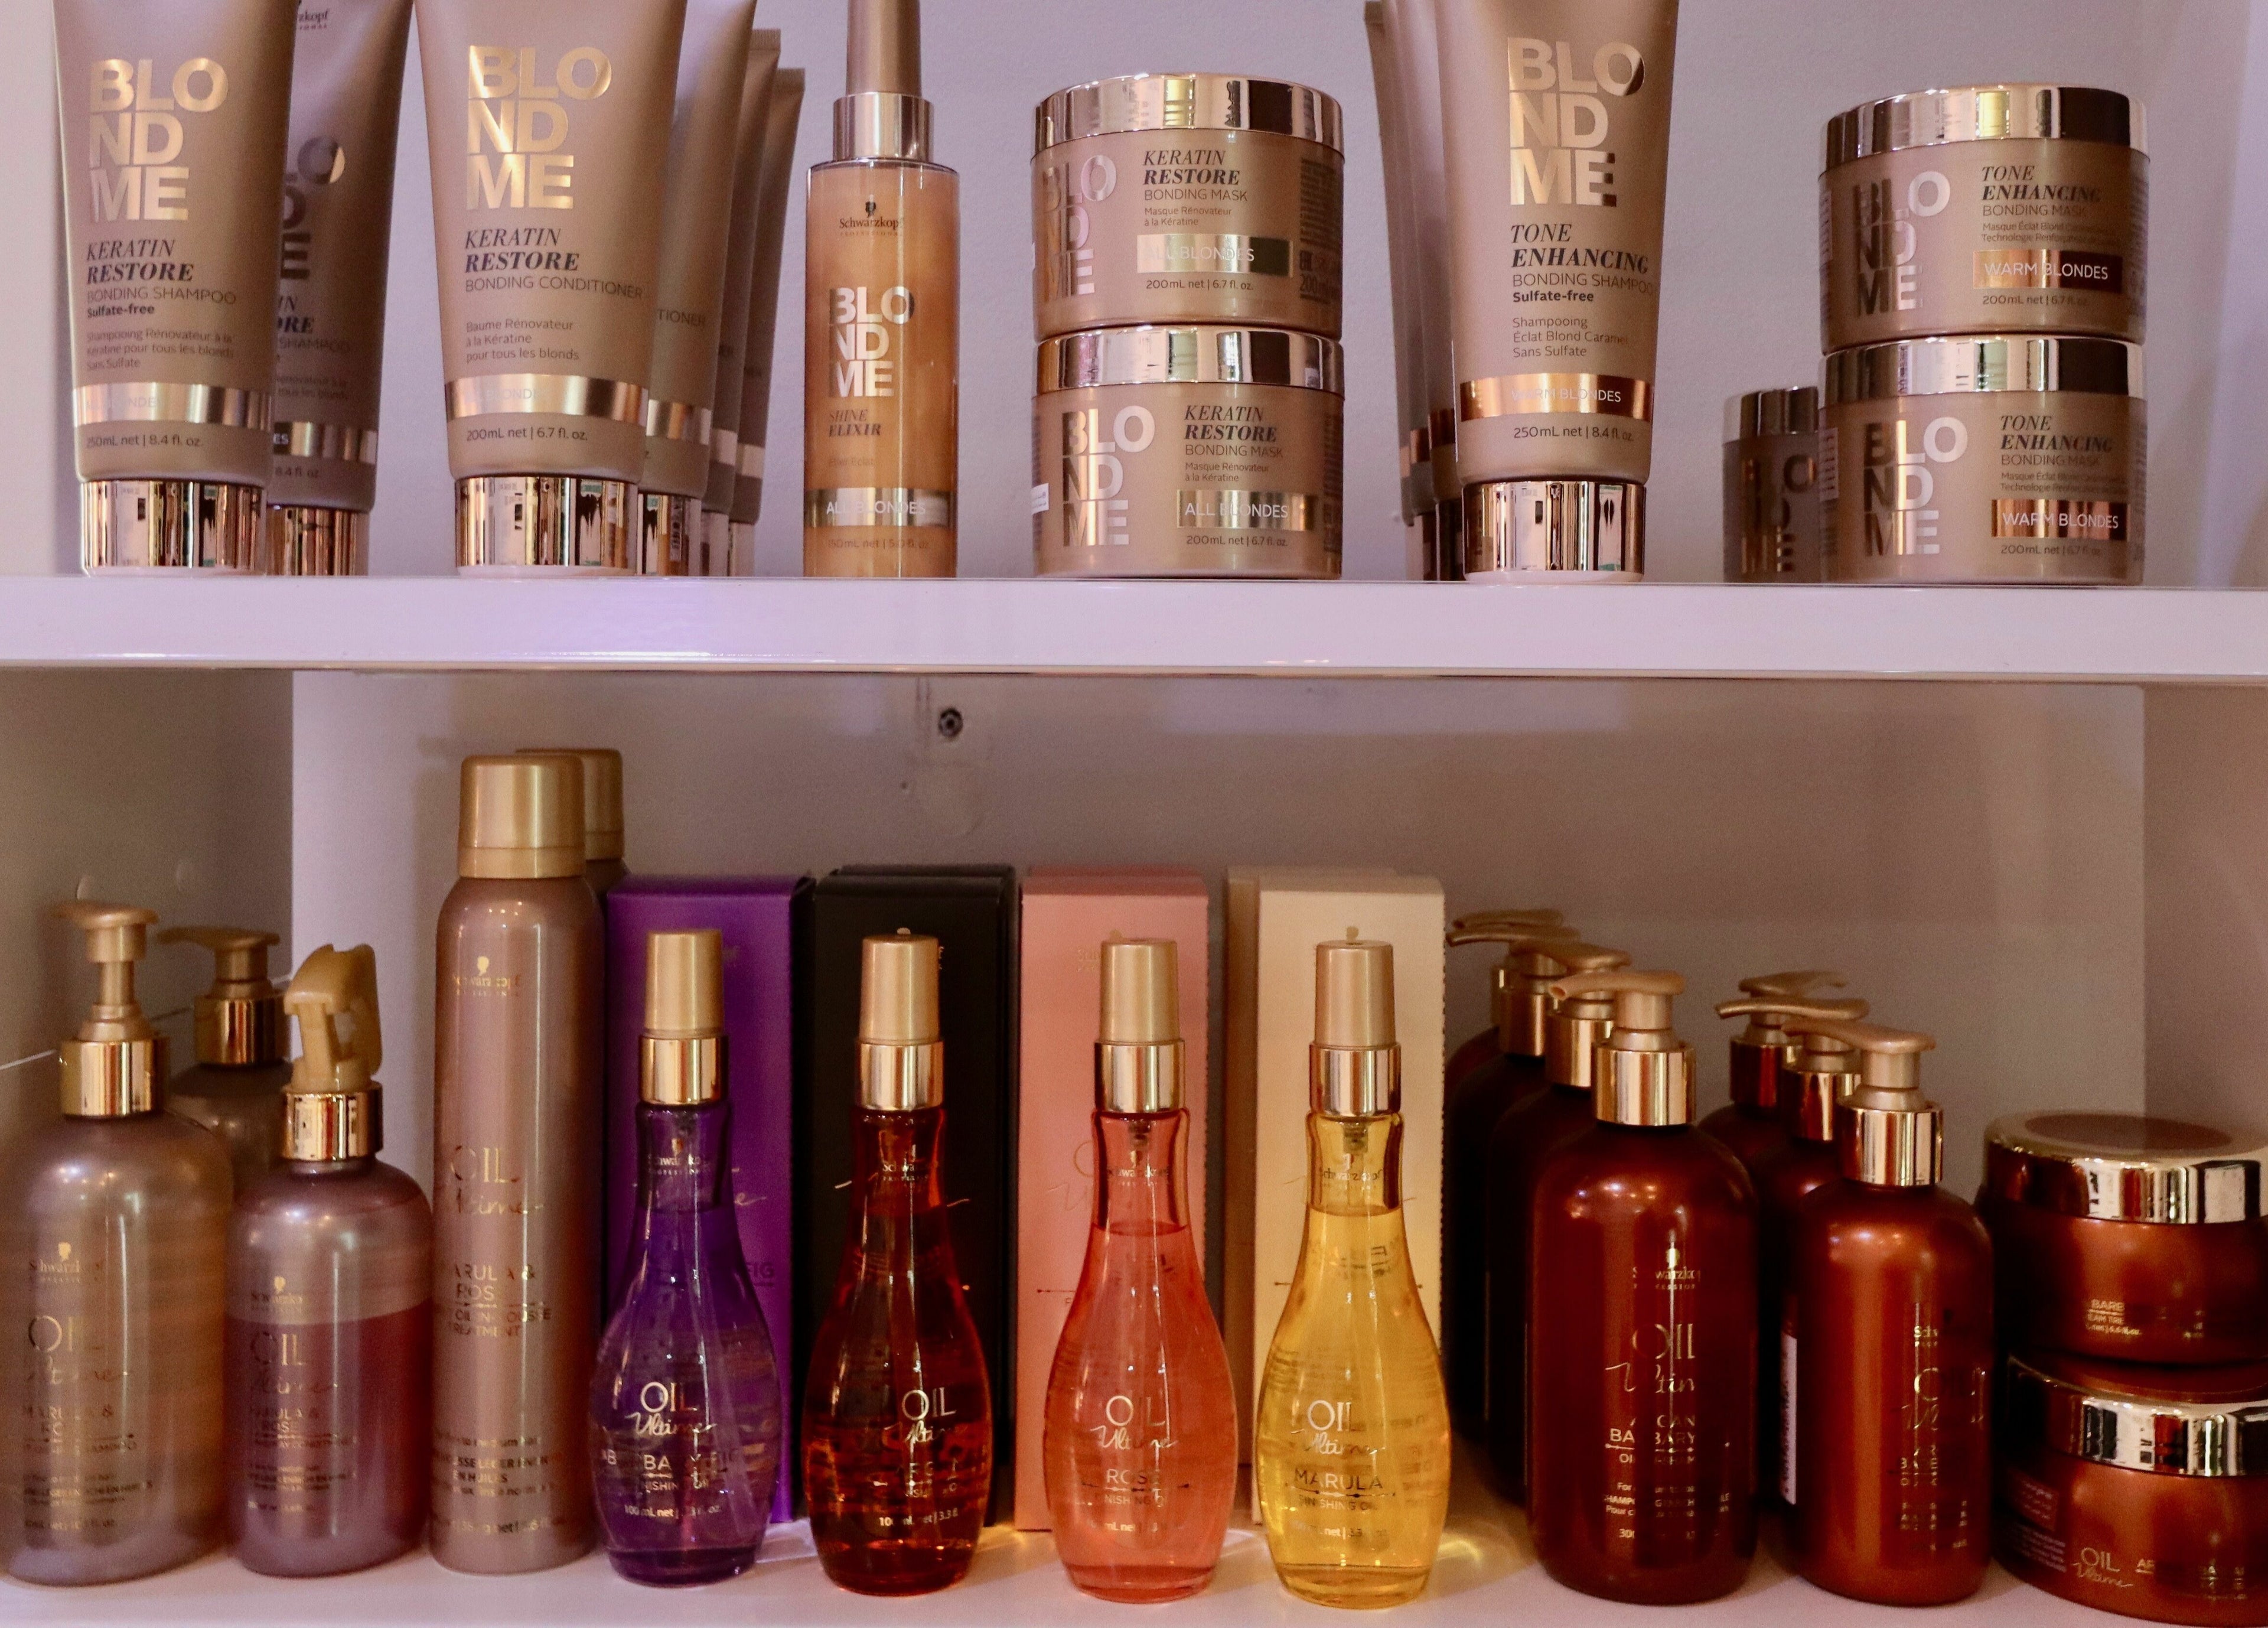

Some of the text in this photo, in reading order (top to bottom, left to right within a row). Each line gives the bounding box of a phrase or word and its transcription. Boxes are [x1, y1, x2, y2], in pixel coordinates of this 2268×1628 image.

[470, 45, 612, 100] BLO
[1507, 37, 1645, 96] BLO
[90, 58, 229, 113] BLO
[467, 100, 569, 154] ND
[1509, 92, 1608, 148] ND
[89, 112, 184, 168] ND
[1143, 149, 1226, 167] KERATIN
[467, 153, 574, 210] ME
[1143, 168, 1240, 186] RESTORE
[1510, 148, 1617, 207] ME
[1982, 165, 2035, 182] TONE
[90, 166, 189, 223] ME
[1144, 189, 1248, 202] BONDING MASK
[1982, 184, 2101, 203] ENHANCING
[1144, 206, 1232, 218] Masque Rénovateur
[1983, 204, 2048, 216] BONDING
[1152, 217, 1159, 226] la
[1161, 217, 1199, 226] Kératine
[465, 228, 561, 249] KERATIN
[1511, 223, 1572, 243] TONE
[87, 239, 175, 261] KERATIN
[1180, 246, 1255, 262] BLONDES
[465, 251, 579, 273] RESTORE
[1511, 248, 1649, 274] ENHANCING
[87, 262, 194, 284] RESTORE
[1513, 272, 1588, 287] BONDING
[1985, 263, 2109, 280] WARM BLONDES
[465, 276, 643, 298] BONDING CONDITIONER
[1146, 279, 1186, 290] 200mL
[1188, 280, 1205, 289] net
[1213, 279, 1227, 289] 6.7
[87, 286, 236, 305] BONDING SHAMPOO
[1513, 290, 1594, 303] Sulfate-free
[1983, 295, 2024, 305] 200mL
[2027, 295, 2042, 305] net
[87, 304, 155, 318] Sulfate-free
[829, 286, 915, 325] BLO
[467, 321, 501, 333] Baume
[1513, 317, 1588, 330] Shampooing
[485, 334, 532, 344] Kératine
[829, 323, 889, 361] ND
[1513, 330, 1542, 343] Éclat
[1546, 331, 1581, 342] Blond
[467, 348, 580, 363] pour tous les blonds
[1513, 345, 1587, 358] Sans Sulfate
[829, 360, 894, 398] ME
[1560, 389, 1621, 403] BLONDES
[830, 409, 868, 422] SHINE
[1184, 405, 1264, 422] KERATIN
[829, 423, 881, 438] ELIXIR
[1063, 405, 1155, 456] BLO
[2001, 415, 2052, 431] TONE
[121, 435, 139, 446] net
[467, 428, 504, 441] 200mL
[508, 428, 527, 438] net
[537, 427, 555, 438] 6.7
[1184, 425, 1276, 442] RESTORE
[1514, 426, 1560, 439] 250mL
[1562, 427, 1582, 438] net
[1592, 427, 1609, 438] 8.4
[1864, 416, 1968, 465] BLO
[1185, 444, 1282, 458] BONDING MASK
[2000, 434, 2113, 453] ENHANCING
[1185, 462, 1220, 473] Masque
[2001, 454, 2065, 465] BONDING
[1063, 455, 1123, 502] ND
[1192, 473, 1200, 482] la
[1202, 473, 1239, 483] Kératine
[1864, 464, 1934, 512] ND
[1185, 503, 1289, 519] ALL BLONDES
[1063, 499, 1129, 547] ME
[2059, 513, 2119, 529] BLONDES
[1186, 535, 1226, 546] 200mL
[1228, 536, 1244, 546] net
[1252, 536, 1265, 546] 6.7
[1864, 509, 1940, 556] ME
[2001, 545, 2042, 555] 200mL
[2044, 545, 2060, 554] net
[640, 1381, 699, 1413] OIL
[902, 1387, 957, 1421] OIL
[1295, 1468, 1383, 1490] MARULA
[2080, 1546, 2121, 1572] OIL
